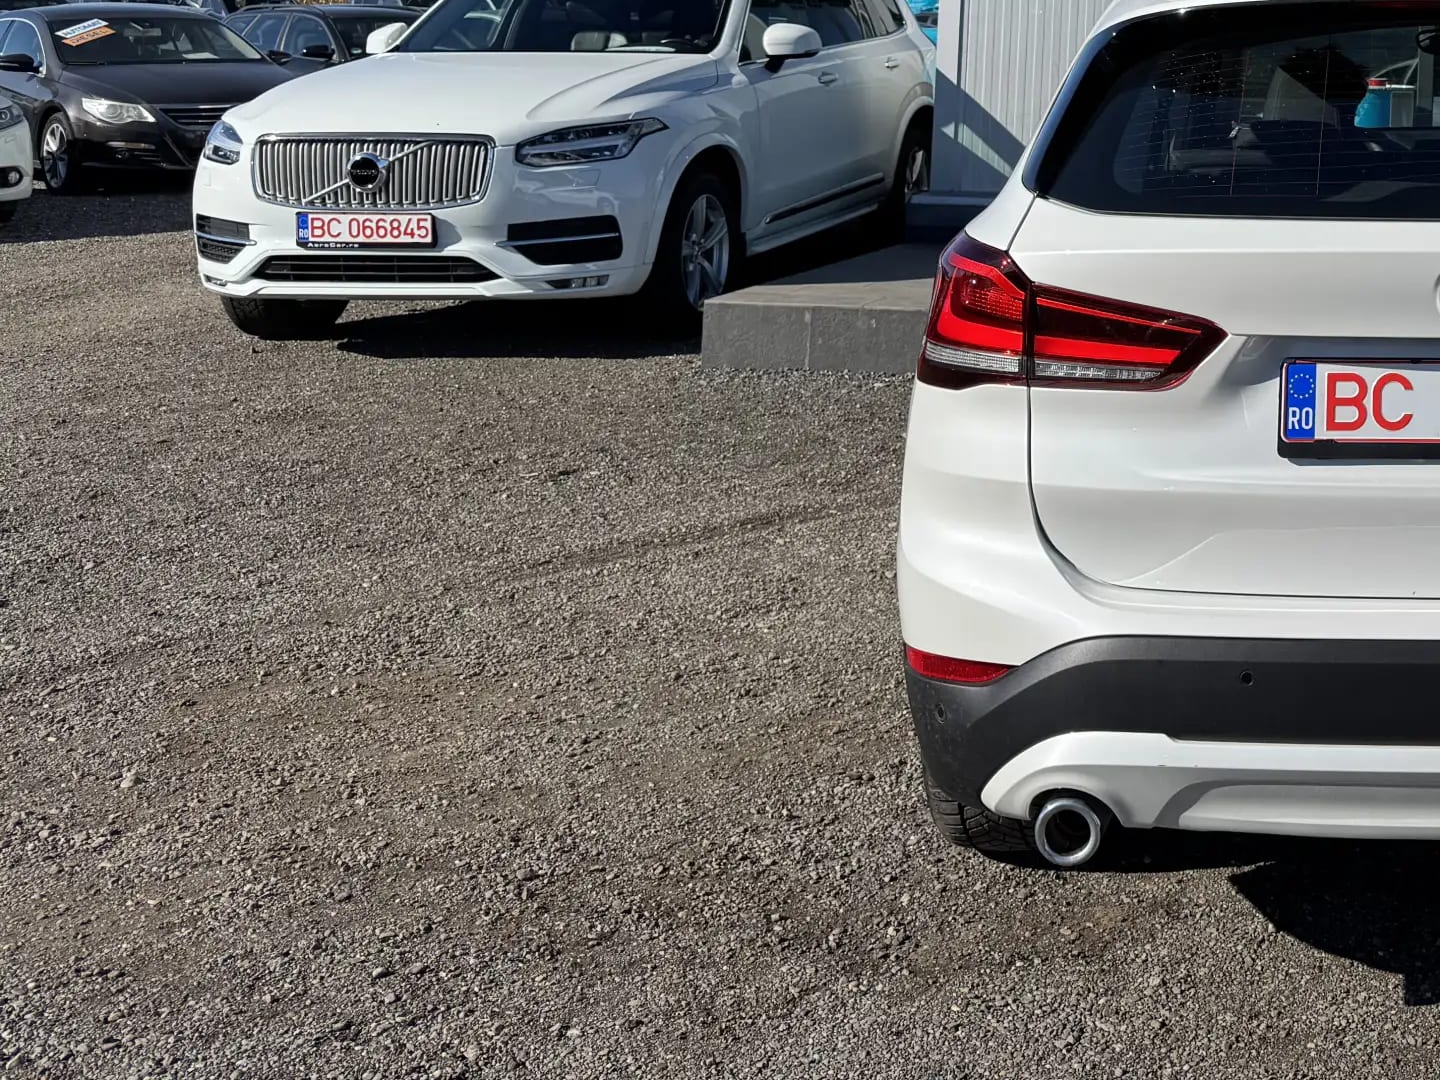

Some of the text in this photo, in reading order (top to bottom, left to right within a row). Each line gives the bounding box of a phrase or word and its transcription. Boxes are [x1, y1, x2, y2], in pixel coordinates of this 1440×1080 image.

[299, 217, 429, 239] RO BC 066845
[1287, 406, 1314, 431] RO
[1325, 371, 1414, 432] BC
